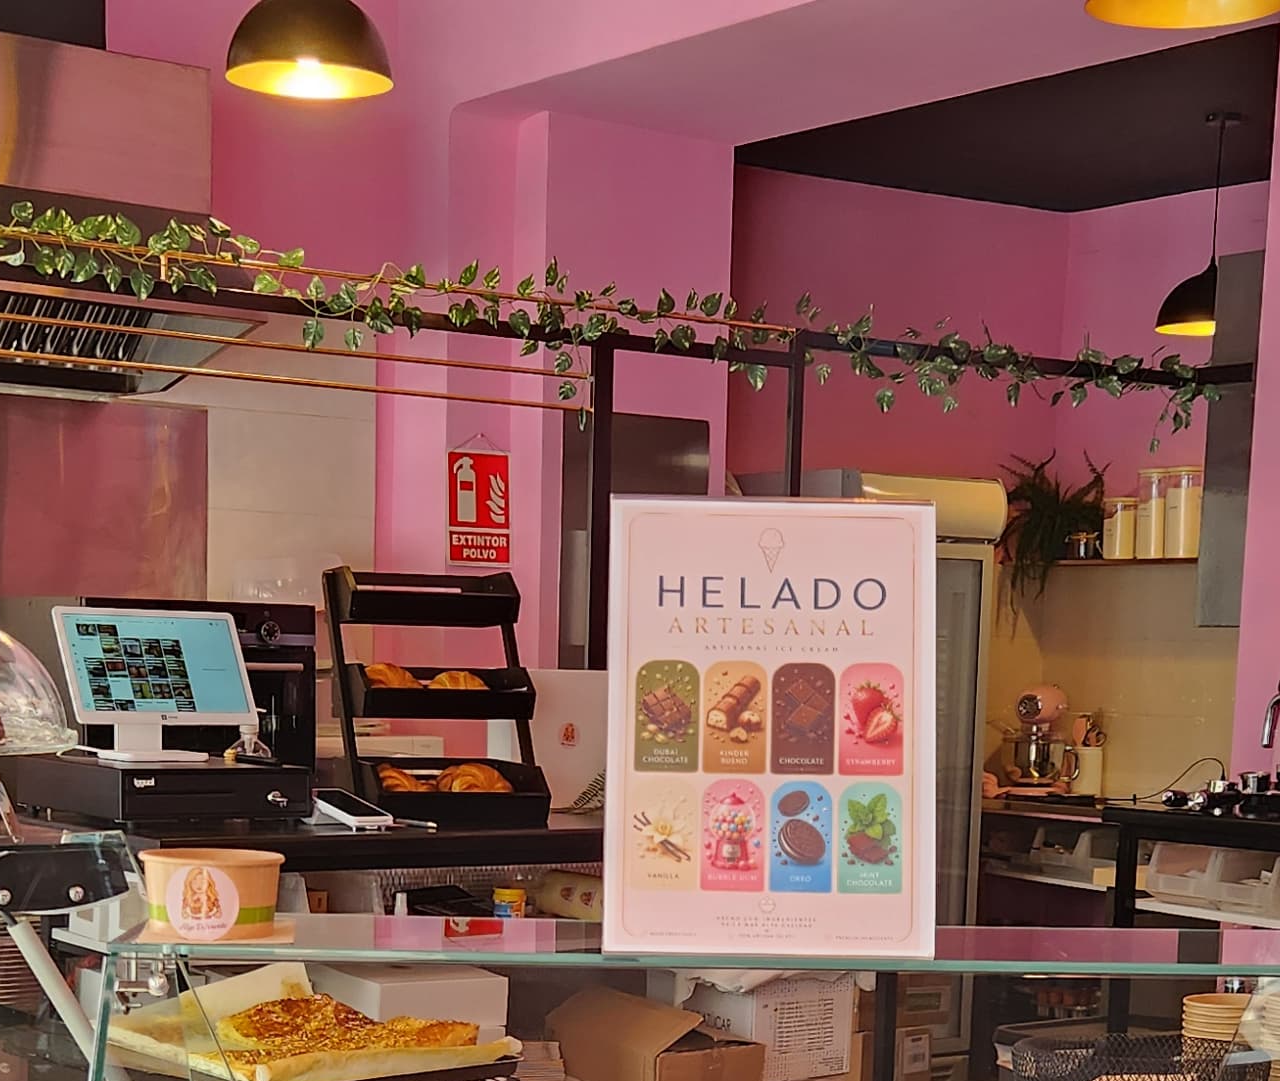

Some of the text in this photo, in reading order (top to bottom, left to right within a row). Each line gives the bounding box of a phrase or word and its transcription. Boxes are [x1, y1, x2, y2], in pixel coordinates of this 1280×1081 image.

[451, 534, 507, 548] EXTINTOR
[462, 548, 497, 560] POLVO
[658, 575, 888, 611] HELADO
[668, 616, 875, 637] ARTESANAL
[779, 757, 824, 766] CHOCOLATE
